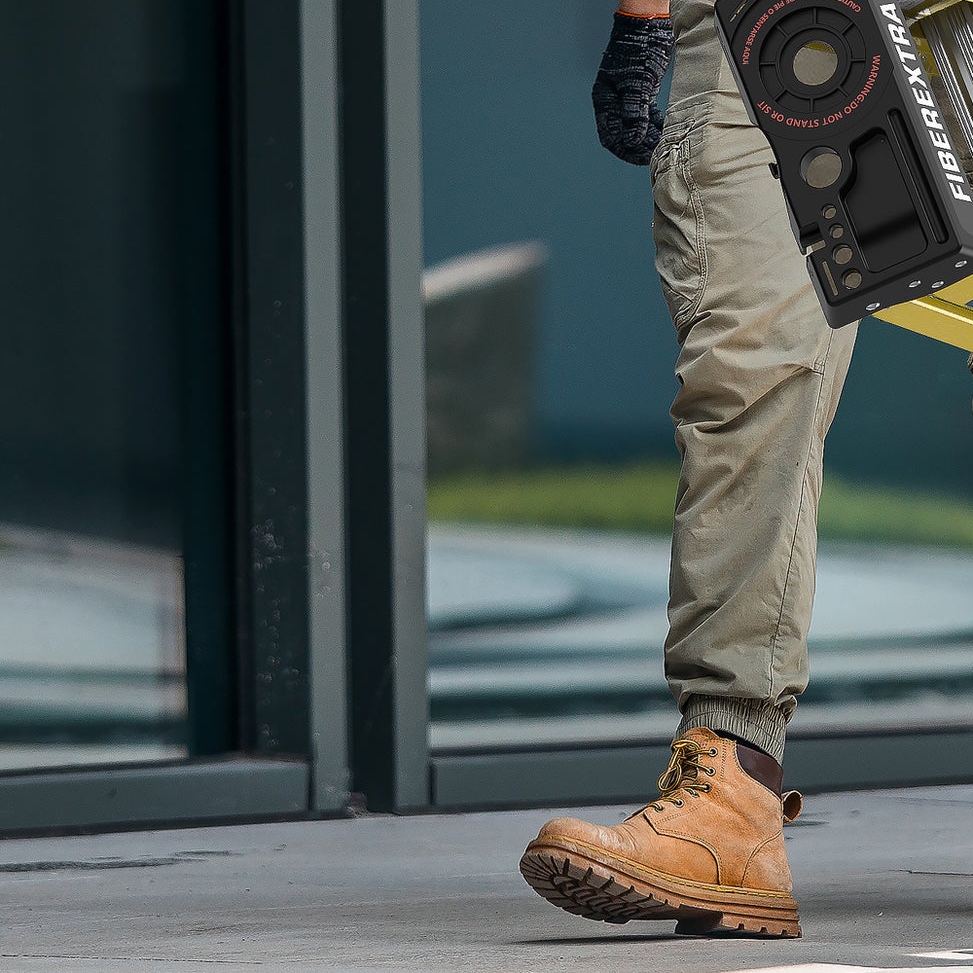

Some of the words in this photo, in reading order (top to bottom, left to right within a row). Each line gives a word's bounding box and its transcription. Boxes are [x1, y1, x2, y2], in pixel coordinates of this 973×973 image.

[773, 1, 785, 11] PIE
[767, 8, 775, 16] O
[746, 14, 768, 45] SENTARSE
[758, 101, 771, 113] SIT
[880, 3, 972, 202] FIBEREXTRA
[771, 112, 784, 122] OR
[822, 111, 844, 126] NOT
[786, 118, 819, 128] STAND
